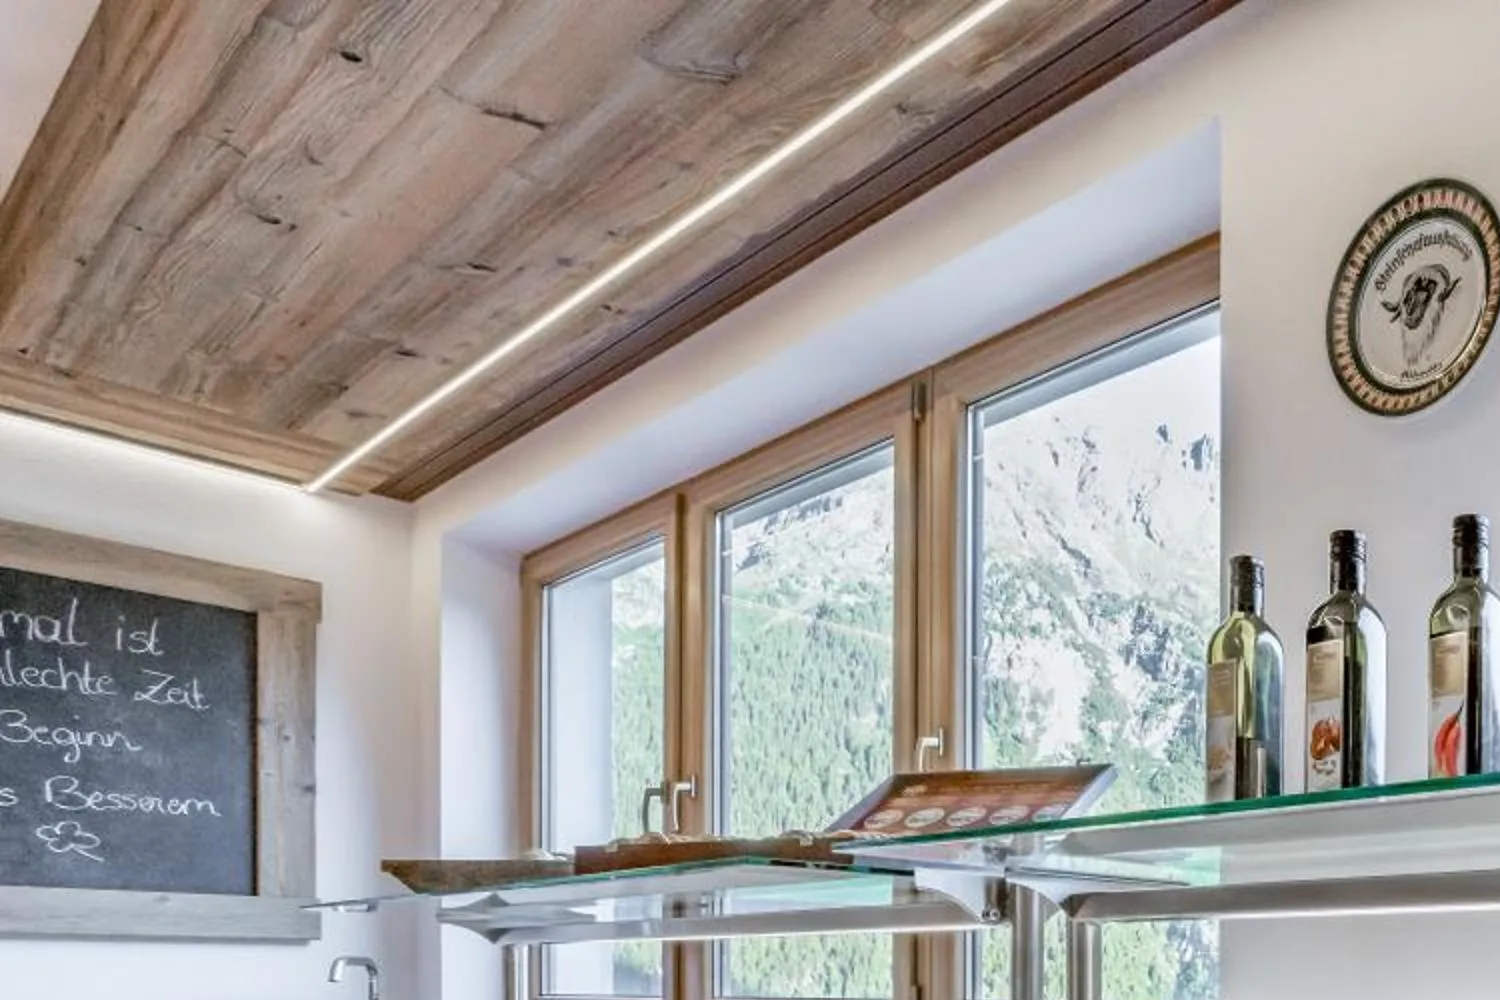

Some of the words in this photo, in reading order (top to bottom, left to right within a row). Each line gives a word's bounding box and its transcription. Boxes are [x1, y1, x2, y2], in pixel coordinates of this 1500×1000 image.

[115, 615, 164, 655] ist
[0, 649, 120, 695] lechte
[134, 667, 210, 710] Zeit
[0, 709, 143, 763] Beginn
[45, 775, 221, 817] Besserem
